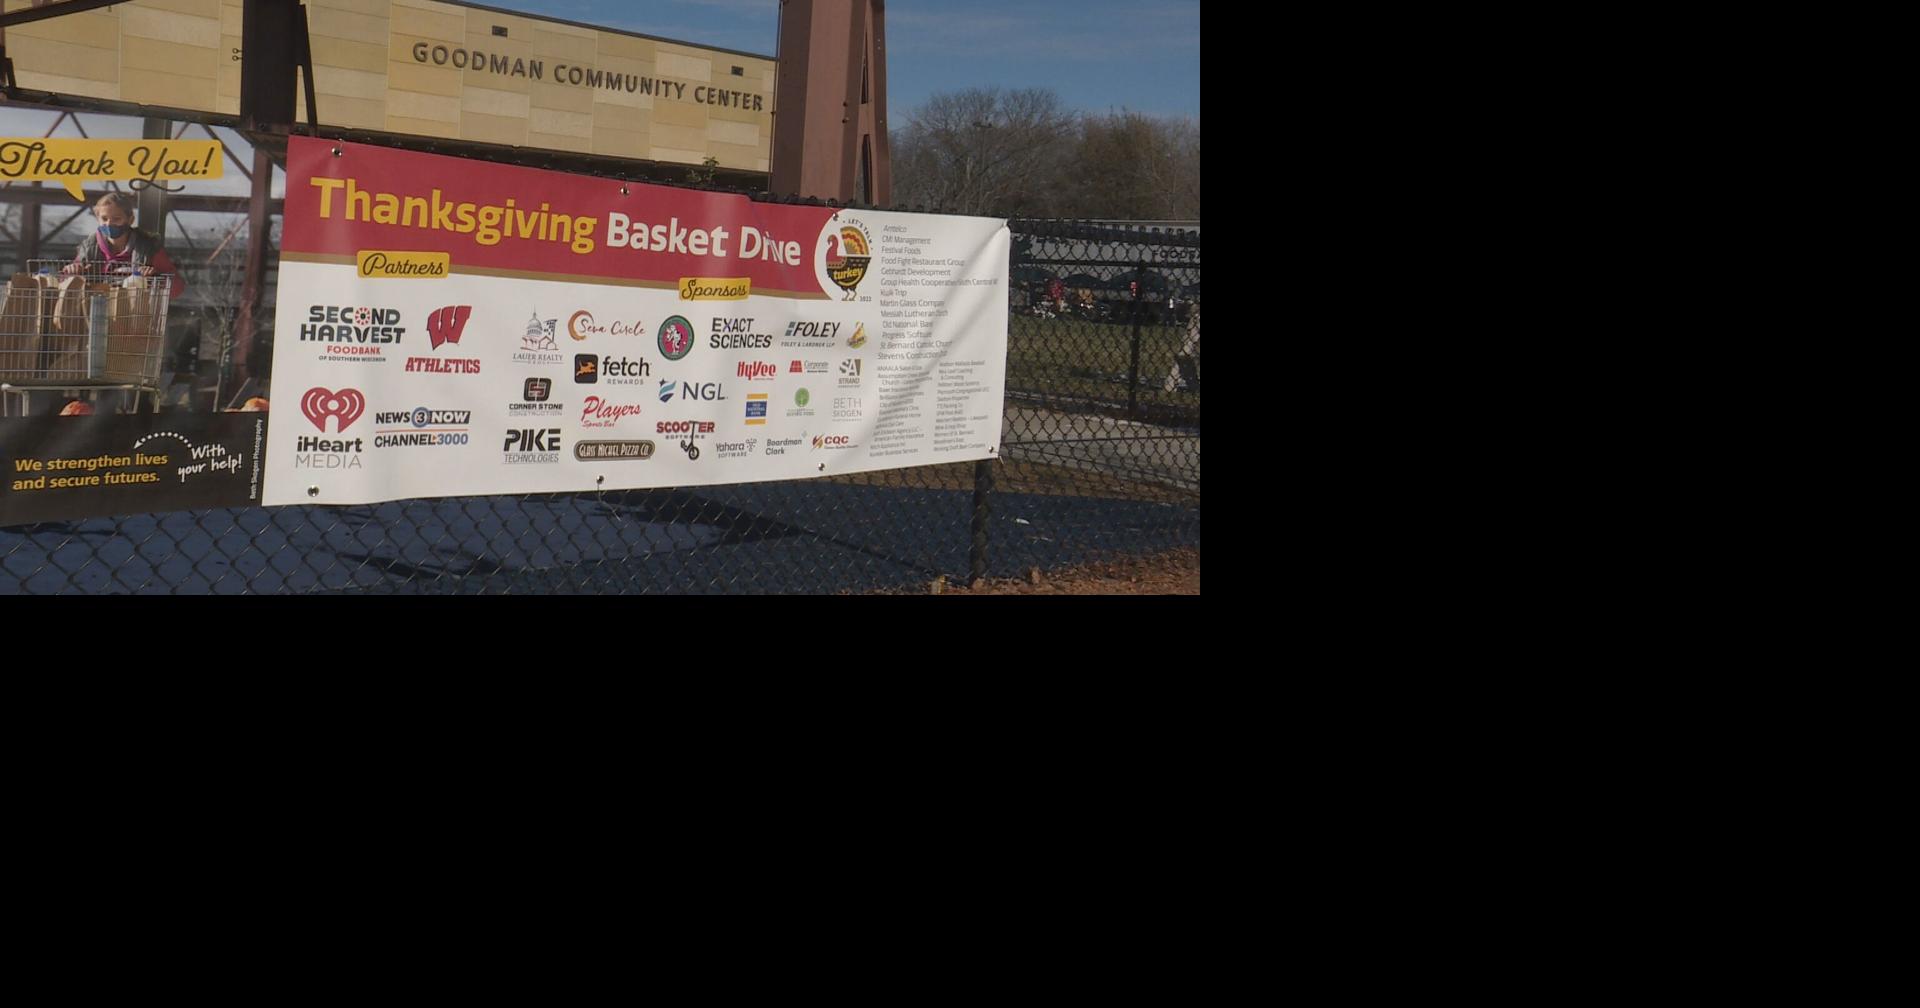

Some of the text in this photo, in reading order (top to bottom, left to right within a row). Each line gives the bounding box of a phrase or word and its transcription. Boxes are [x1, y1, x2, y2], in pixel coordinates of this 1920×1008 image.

[413, 41, 764, 112] GOODMAN COMMUNITY CENTER
[0, 141, 217, 192] Thank You!
[311, 176, 597, 255] Thanksgiving
[606, 212, 729, 257] Basket
[881, 246, 921, 255] Festival Foods
[362, 253, 444, 276] Partners
[881, 256, 896, 264] Food
[912, 258, 946, 266] Restaurant
[833, 267, 864, 280] turkey
[907, 268, 951, 276] Development
[681, 279, 748, 301] Sponsors
[899, 299, 917, 307] Glass
[309, 305, 401, 325] SECOND
[610, 320, 646, 336] Circle
[712, 317, 754, 333] EXACT
[792, 321, 841, 338] FOLEY
[300, 323, 406, 344] HARVEST
[710, 334, 773, 349] SCIENCES
[327, 345, 381, 355] FOODBANK
[405, 357, 481, 374] ATHLETICS
[602, 356, 650, 377] fetch
[682, 382, 727, 401] NGL
[581, 395, 641, 422] Players
[833, 397, 862, 409] BETH
[375, 411, 410, 424] NEWS
[431, 411, 469, 423] NOW
[656, 420, 715, 434] SCOOTER
[252, 417, 263, 459] Photography
[297, 435, 363, 453] iHeart
[374, 433, 469, 448] CHANNEL 3000
[503, 428, 561, 452] PIKE
[766, 438, 802, 447] Boardman
[824, 435, 849, 445] CQC
[191, 445, 226, 459] With
[716, 441, 745, 452] Yahara
[765, 447, 785, 456] Clark
[15, 453, 168, 472] We strengthen lives
[295, 453, 362, 470] MEDIA
[504, 453, 559, 463] TECHNOLOGIES
[178, 454, 242, 483] your help!
[13, 471, 160, 491] and secure futures.
